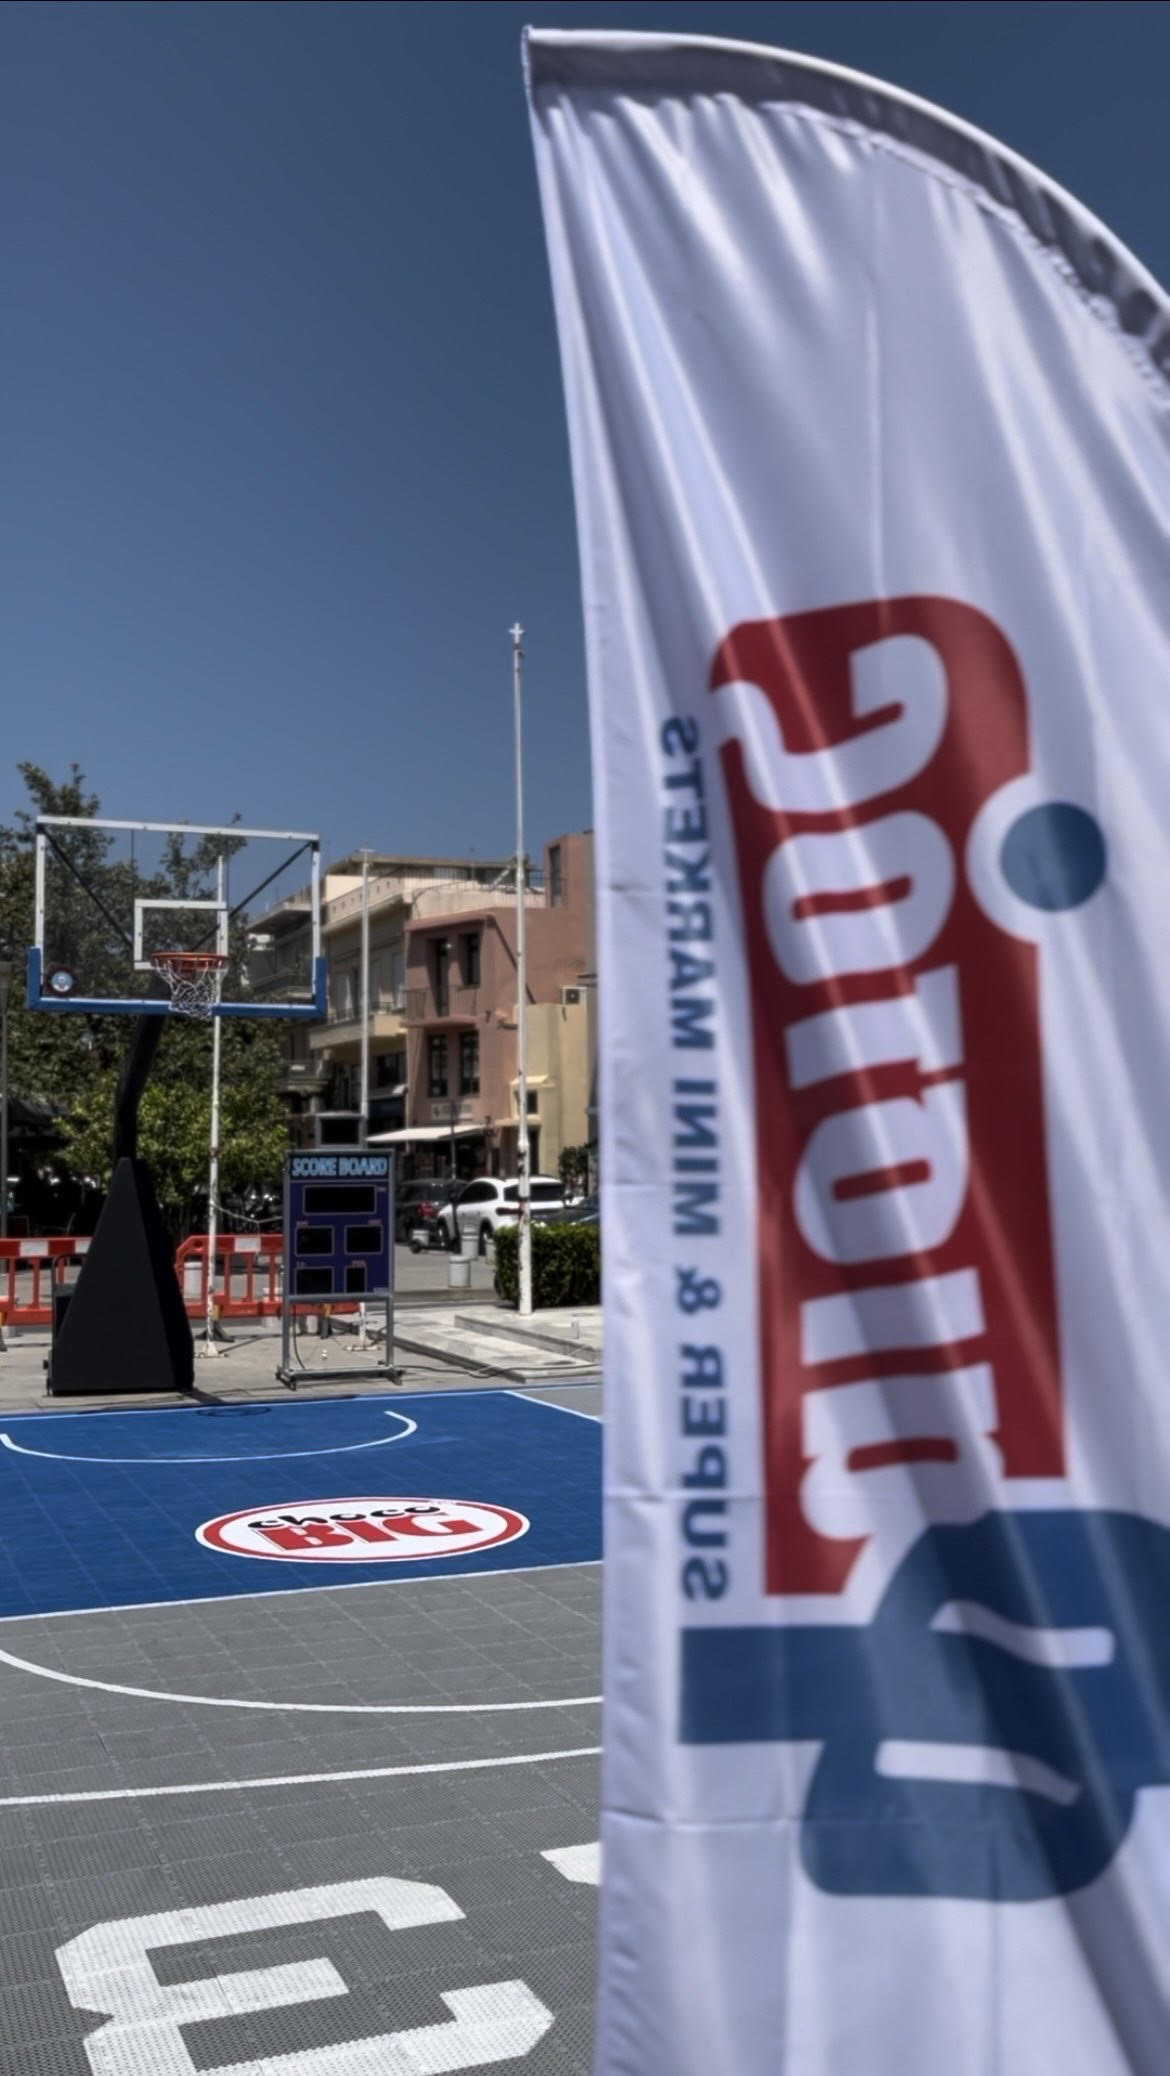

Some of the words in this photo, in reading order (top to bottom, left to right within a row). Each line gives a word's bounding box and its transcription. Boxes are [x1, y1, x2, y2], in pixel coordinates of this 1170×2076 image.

[292, 1157, 337, 1177] SCORE
[338, 1157, 389, 1176] BOARD
[247, 1504, 440, 1529] choco
[255, 1513, 483, 1551] BIG
